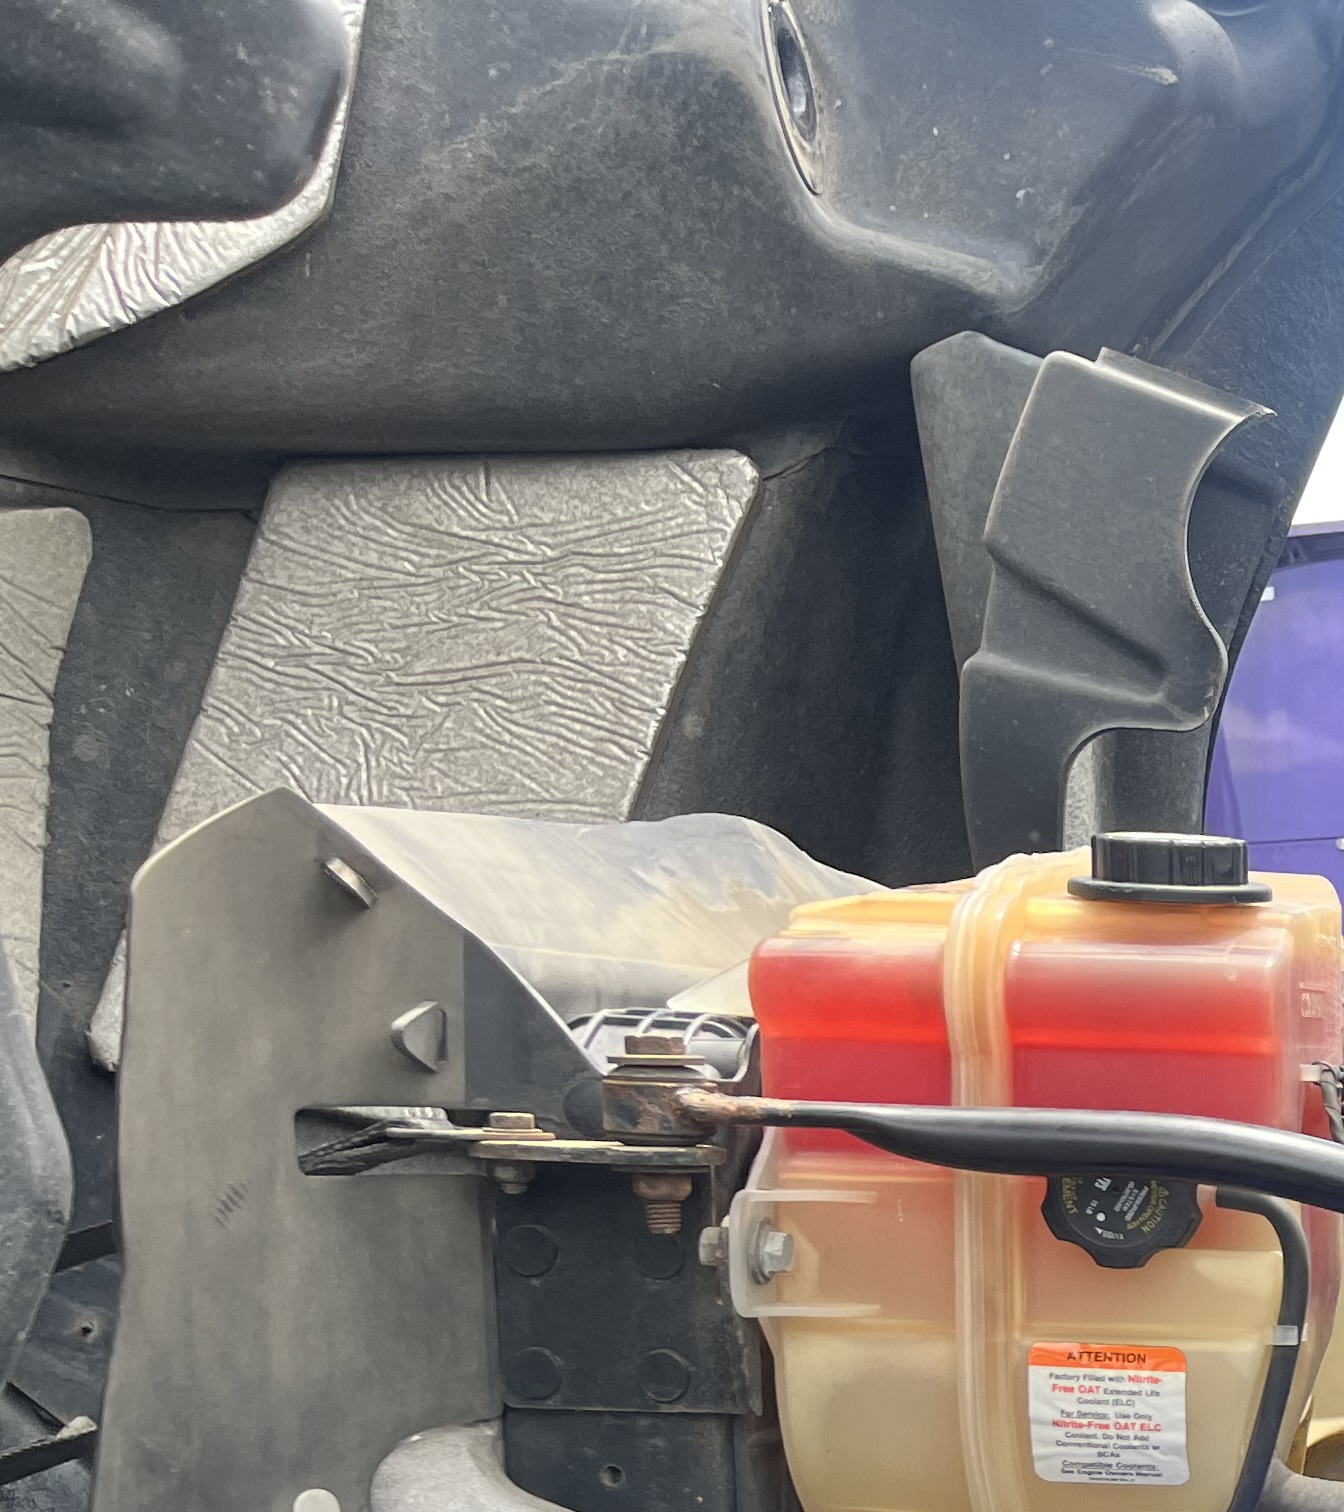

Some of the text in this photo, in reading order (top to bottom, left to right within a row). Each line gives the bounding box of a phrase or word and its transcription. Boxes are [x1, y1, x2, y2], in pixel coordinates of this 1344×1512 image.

[1141, 1198, 1168, 1233] CAUTION
[1067, 1350, 1147, 1364] ATTENTION
[1049, 1372, 1162, 1385] Factory Filled with Nitrite-
[1052, 1384, 1075, 1394] Free
[1078, 1385, 1101, 1394] OAT
[1103, 1388, 1143, 1397] Extended
[1077, 1397, 1136, 1408] Coolant (ELC)
[1060, 1409, 1074, 1418] For
[1115, 1412, 1131, 1420] Use
[1133, 1413, 1153, 1422] Only
[1052, 1419, 1162, 1432] Nitrite-Free OAT ELC
[1102, 1432, 1114, 1441] Do
[1116, 1433, 1131, 1441] Not
[1133, 1434, 1150, 1442] Add
[1056, 1440, 1110, 1449] Conventional
[1112, 1442, 1149, 1451] Coolants
